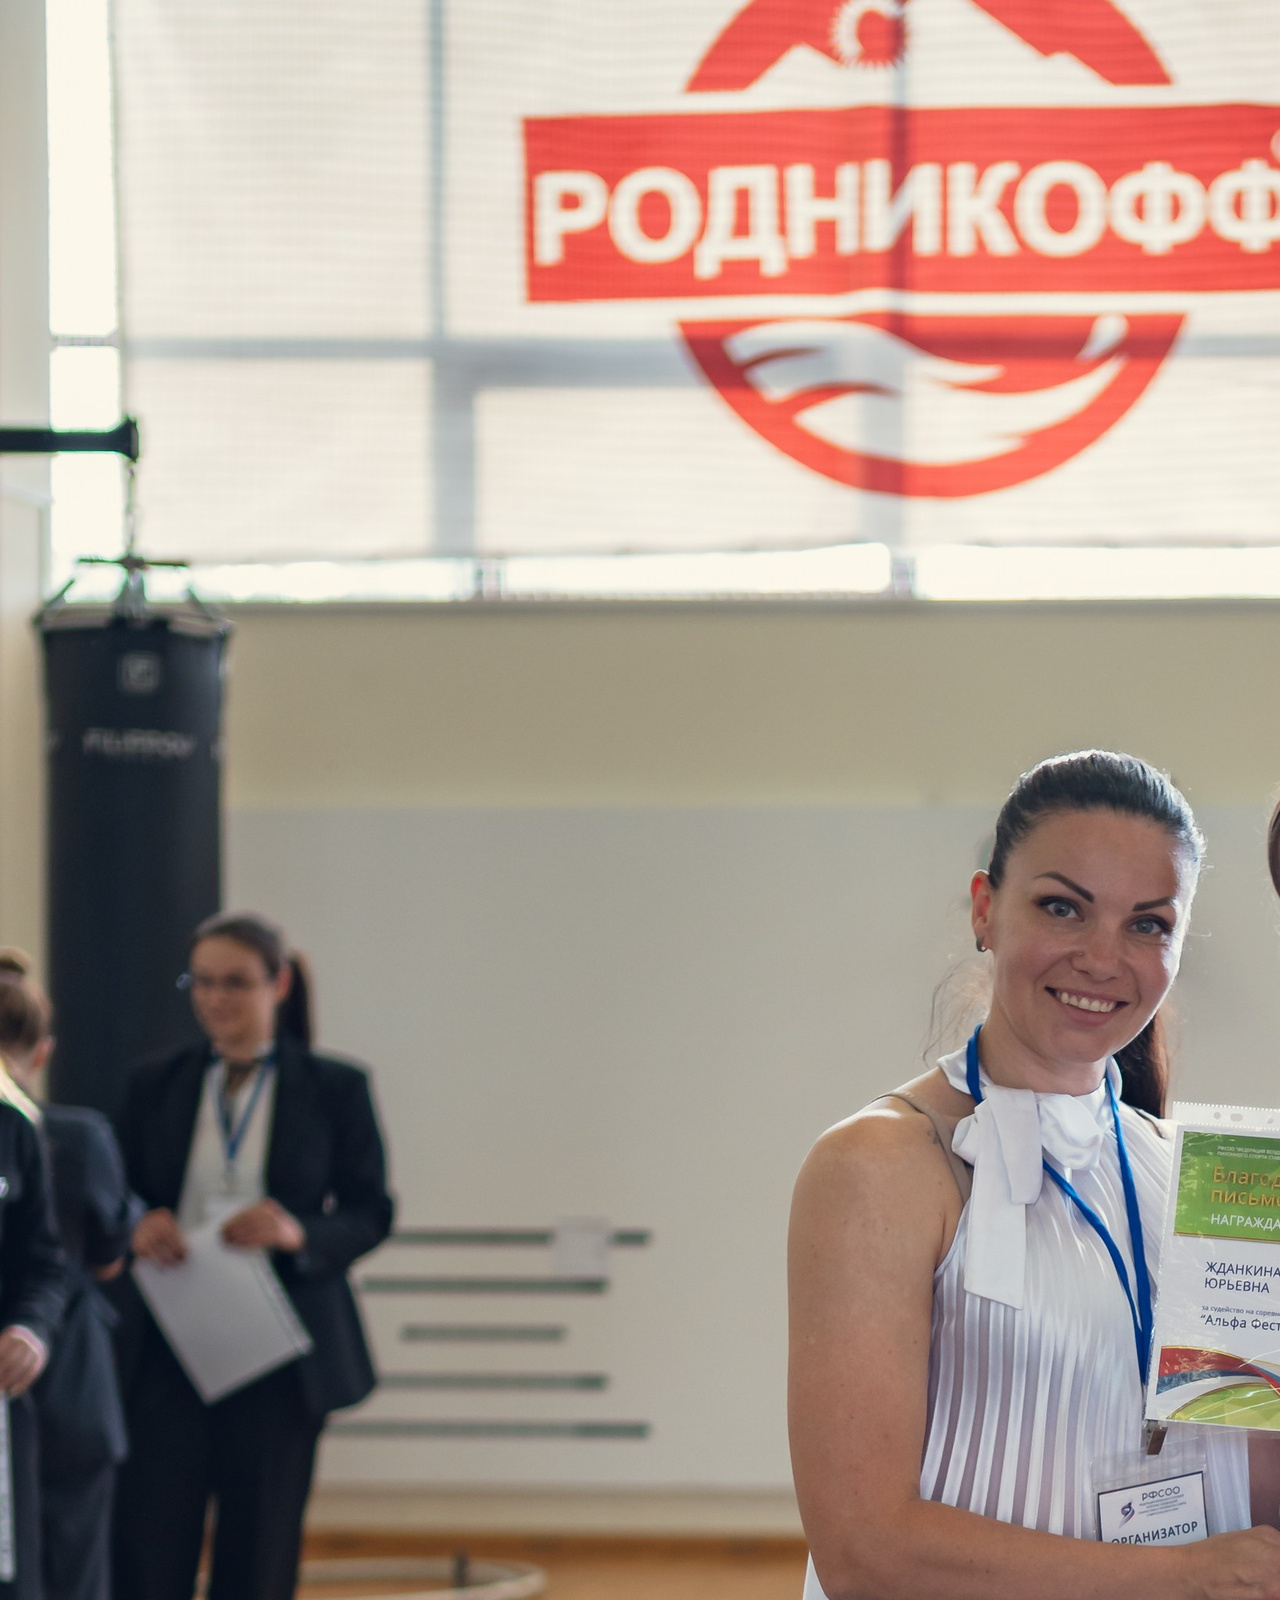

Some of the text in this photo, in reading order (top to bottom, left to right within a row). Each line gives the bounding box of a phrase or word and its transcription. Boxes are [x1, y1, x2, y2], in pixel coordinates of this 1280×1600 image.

[1205, 1261, 1280, 1278] ЖДАНКИНА
[1204, 1277, 1270, 1293] ЮРЬЕВНА
[1210, 1306, 1244, 1314] судейство
[1141, 1486, 1181, 1501] РФСОО
